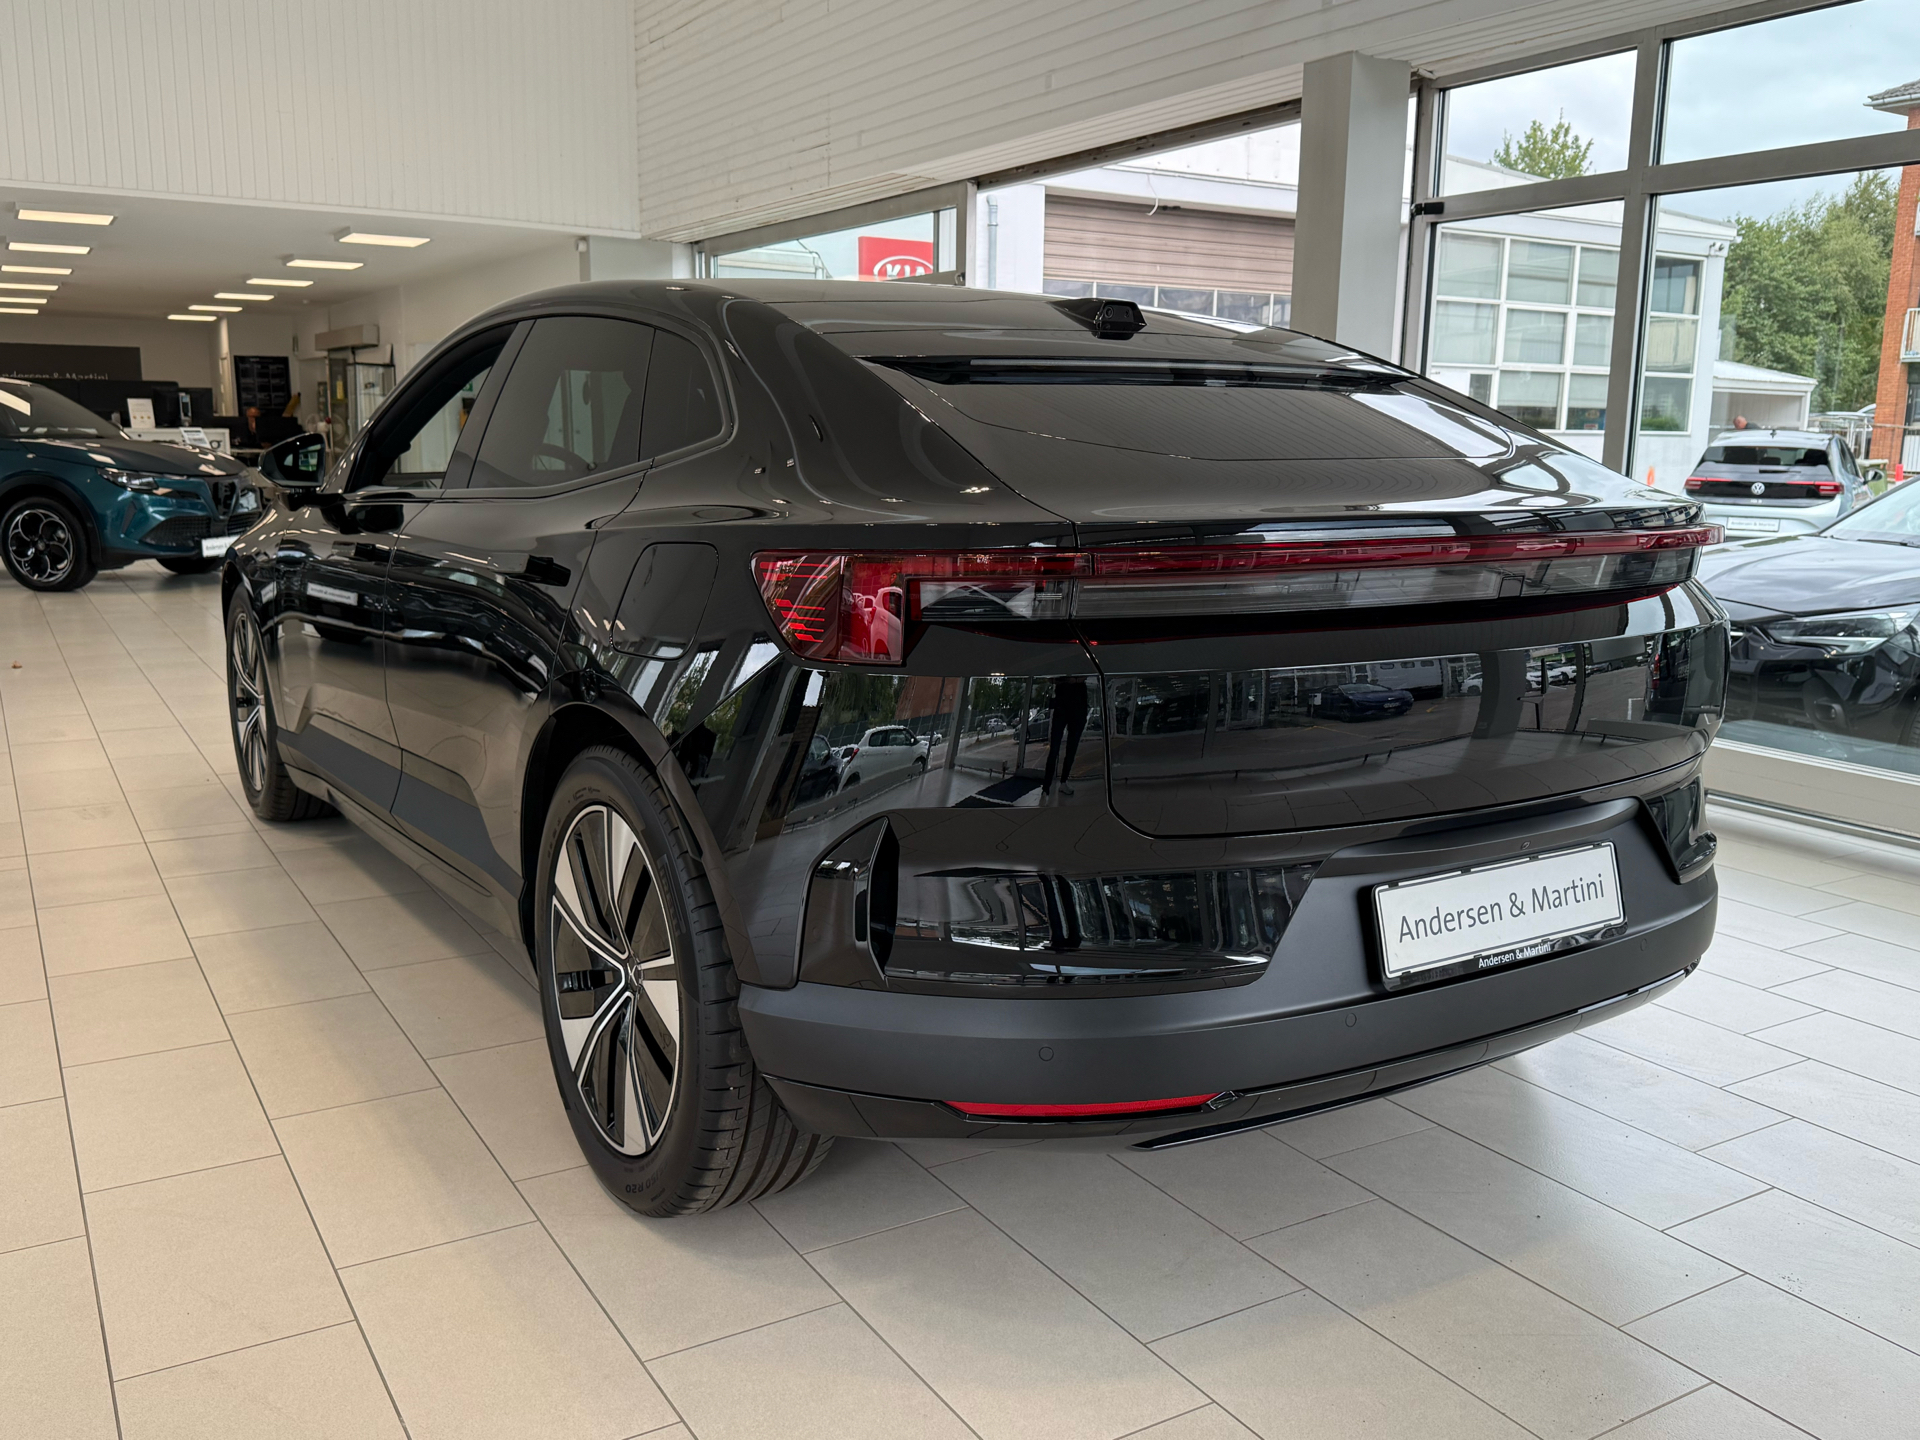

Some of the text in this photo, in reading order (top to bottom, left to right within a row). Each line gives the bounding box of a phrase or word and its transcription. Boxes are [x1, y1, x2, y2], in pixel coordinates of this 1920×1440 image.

[1399, 873, 1604, 943] Andersen & Martini
[1478, 942, 1550, 968] Andersen & Martini
